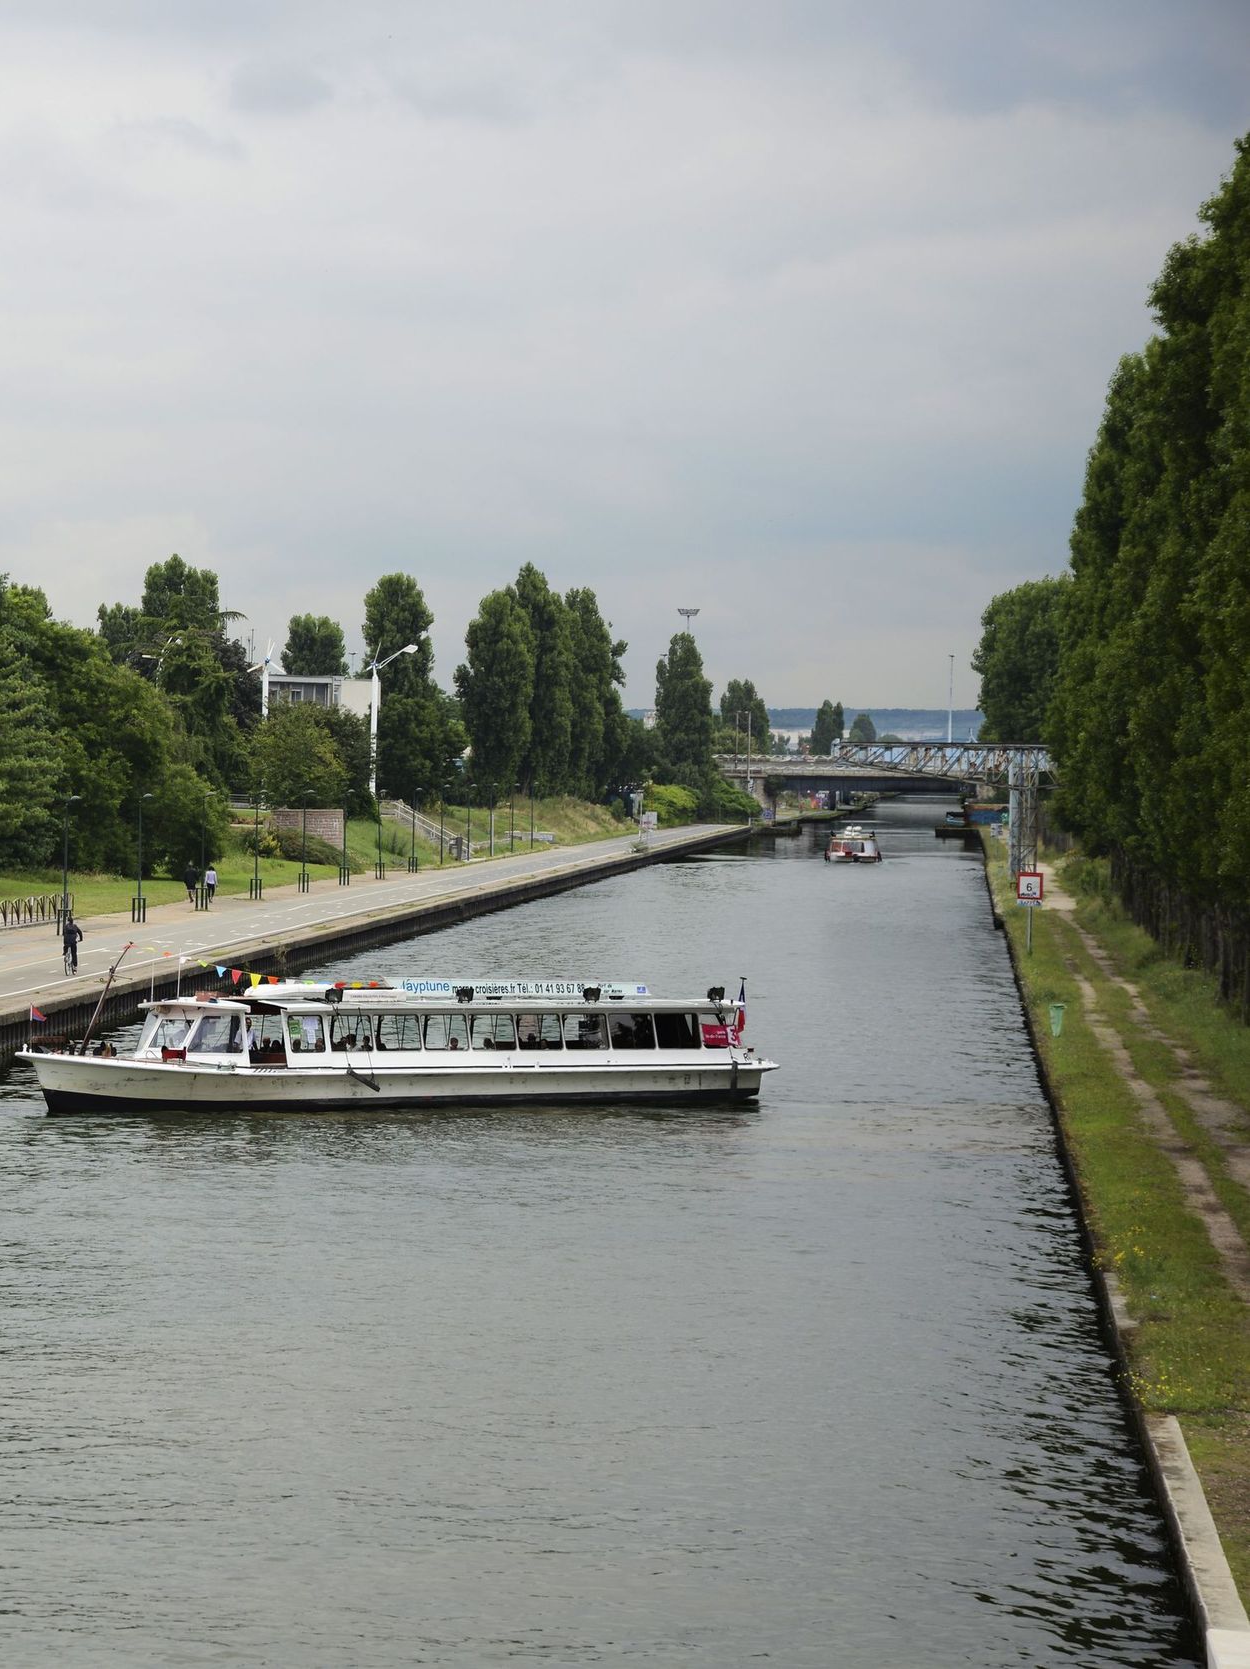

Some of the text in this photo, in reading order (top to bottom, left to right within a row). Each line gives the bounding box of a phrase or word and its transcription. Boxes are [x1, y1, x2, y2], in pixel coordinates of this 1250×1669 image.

[1026, 882, 1033, 892] 6
[475, 983, 516, 994] croisières.fr
[535, 983, 544, 994] 01
[545, 983, 554, 994] 41
[555, 983, 565, 994] 93
[566, 983, 575, 994] 67
